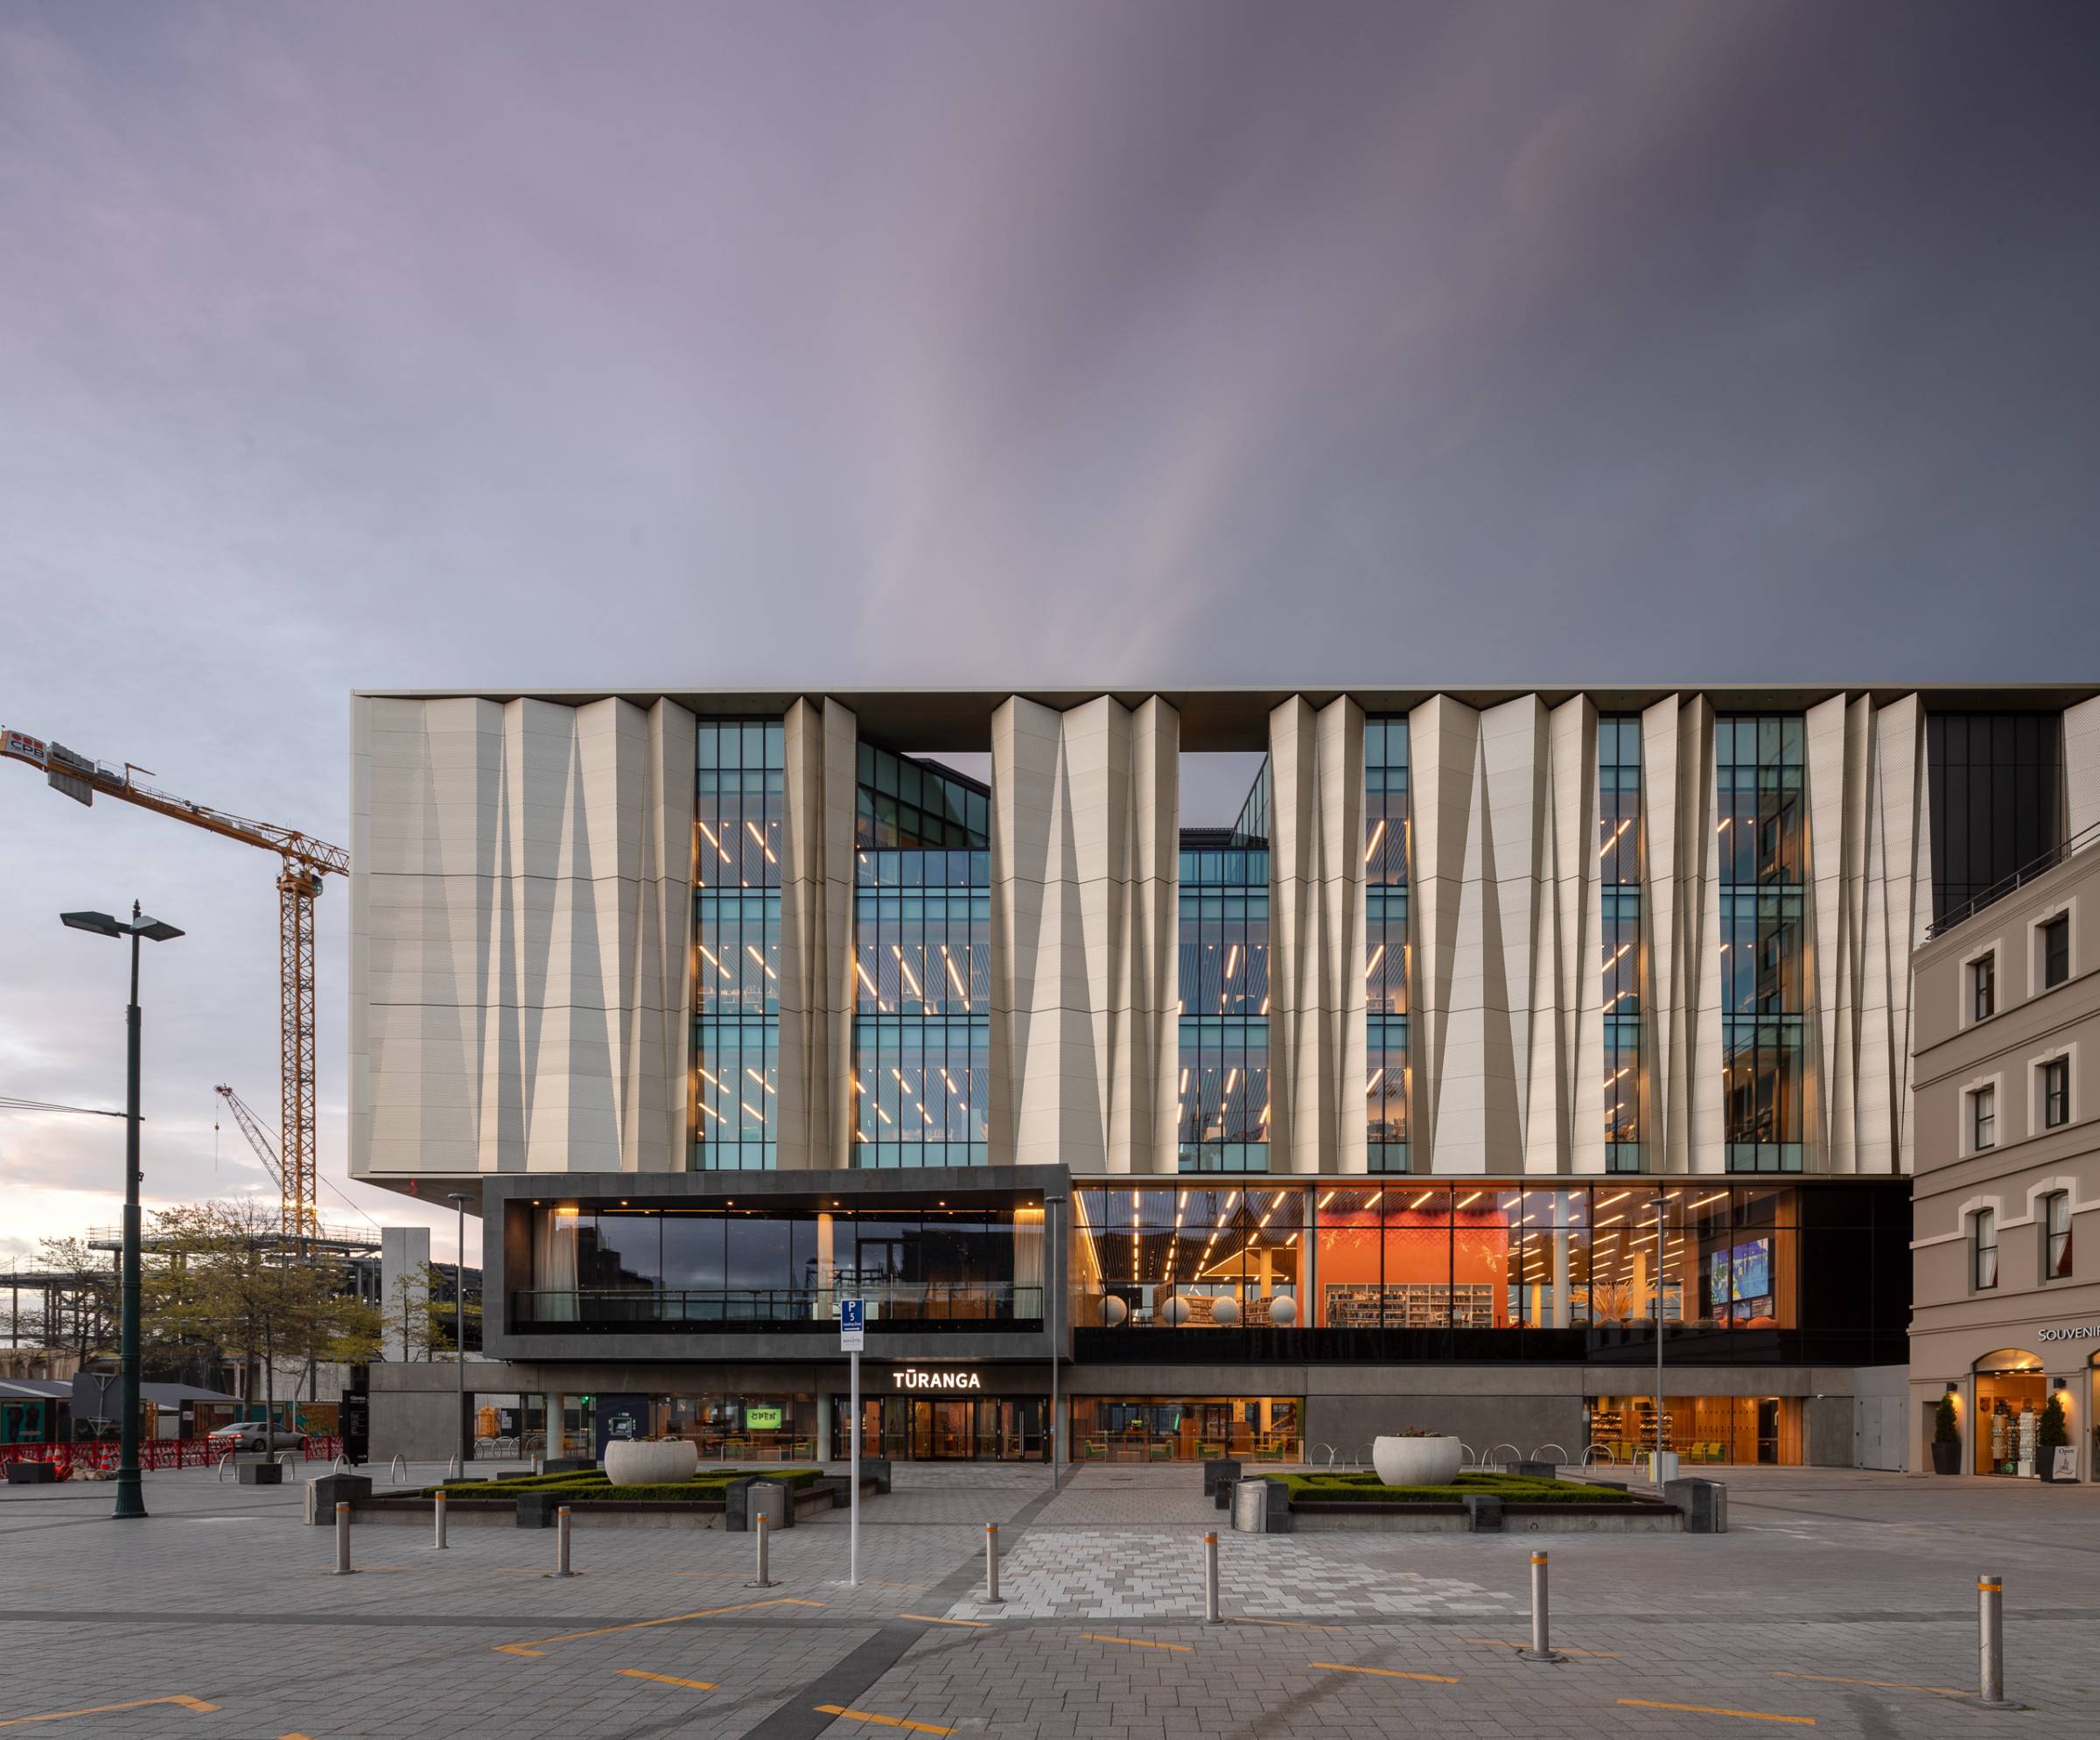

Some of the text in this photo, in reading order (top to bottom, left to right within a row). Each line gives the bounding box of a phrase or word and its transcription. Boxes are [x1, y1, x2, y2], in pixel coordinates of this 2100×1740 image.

[11, 740, 44, 757] CPB
[849, 1301, 856, 1312] P
[850, 1312, 855, 1322] 5
[892, 1369, 981, 1388] TŪRANGA
[751, 1411, 777, 1421] OPEN
